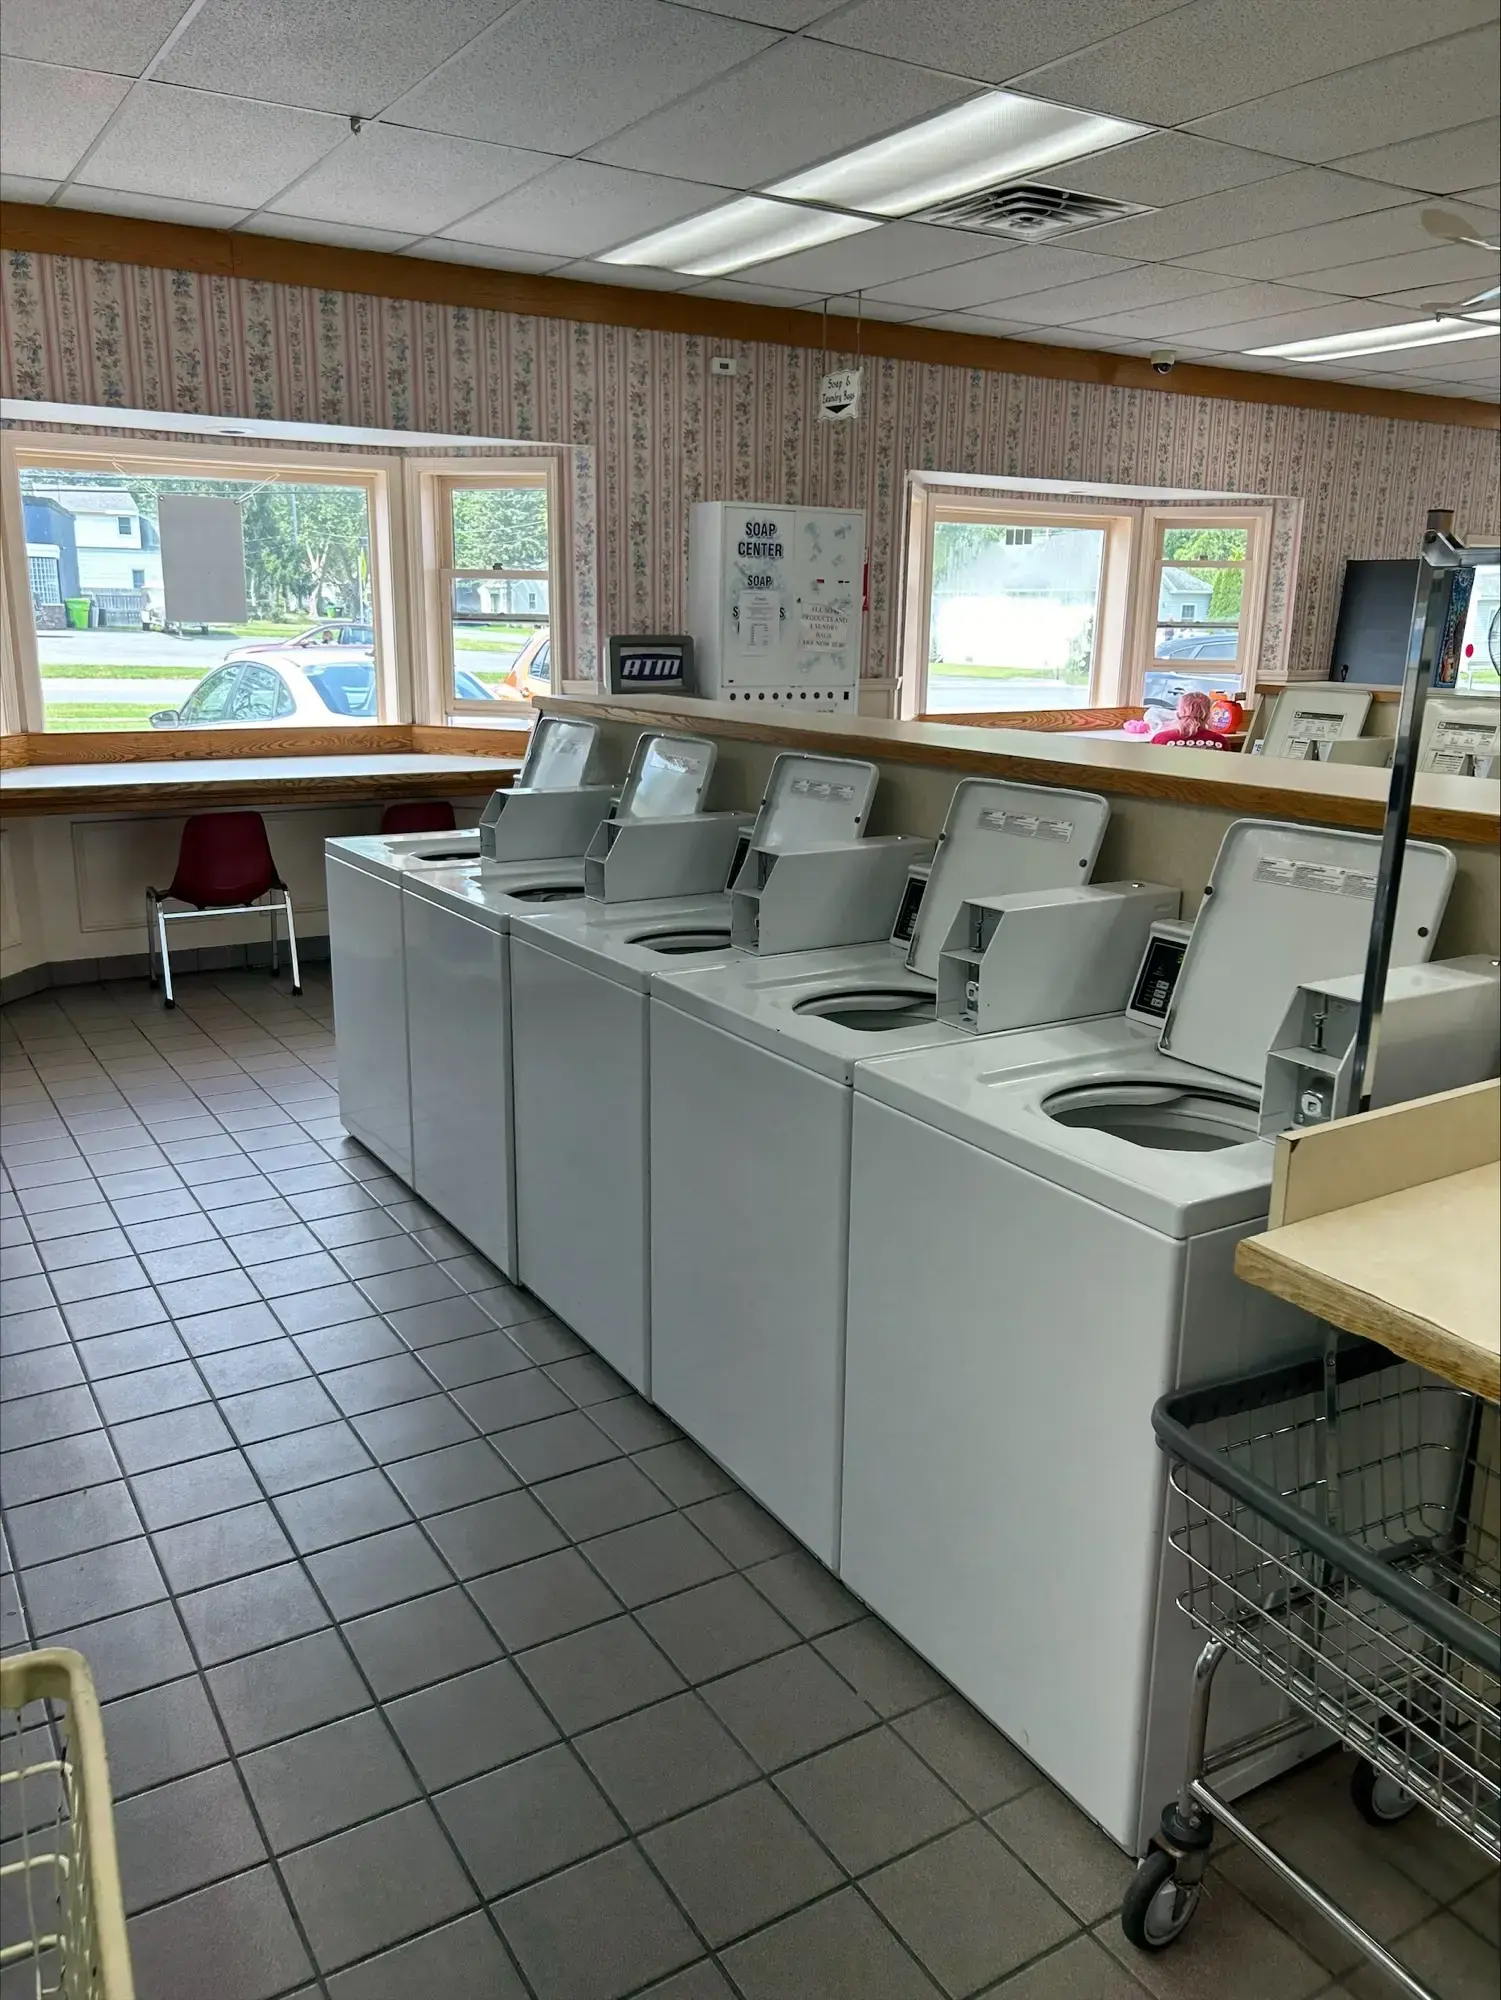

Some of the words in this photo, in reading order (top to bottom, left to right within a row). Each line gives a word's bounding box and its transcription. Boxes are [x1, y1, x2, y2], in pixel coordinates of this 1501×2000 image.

[745, 521, 777, 539] SOAP
[738, 541, 784, 559] CENTER
[747, 574, 773, 589] SOAP
[834, 616, 848, 624] AND
[622, 659, 680, 675] ATM
